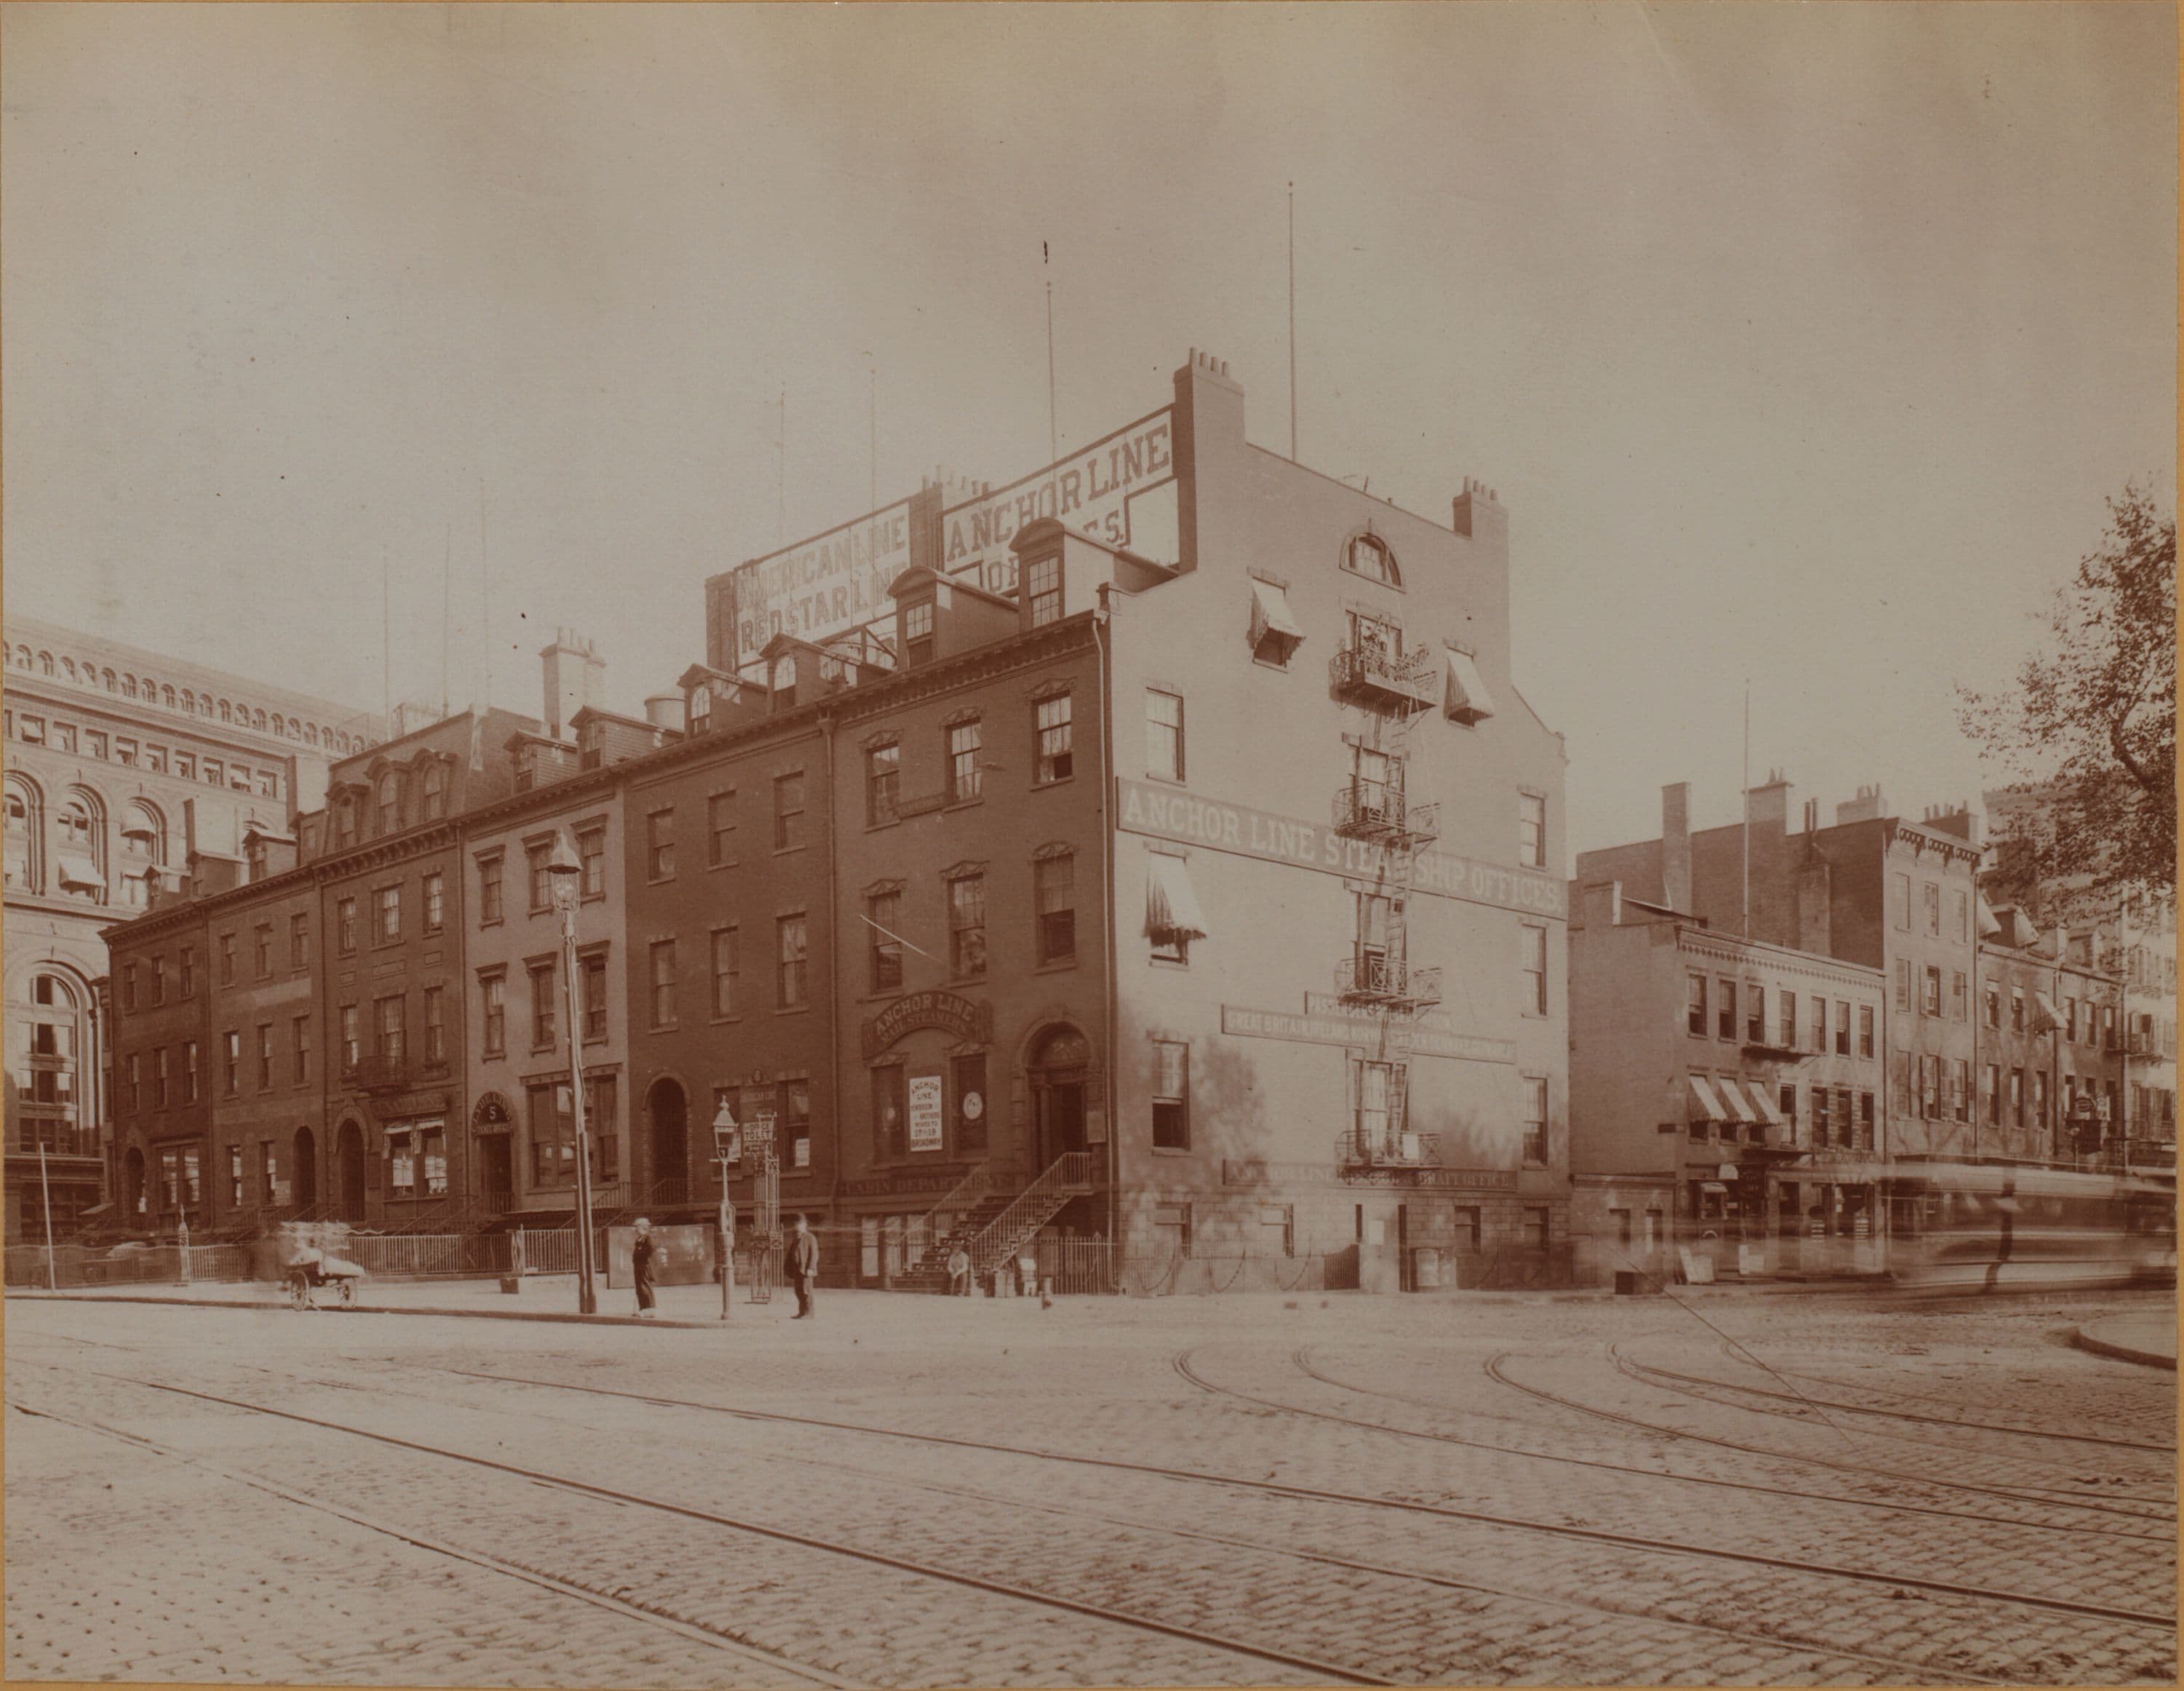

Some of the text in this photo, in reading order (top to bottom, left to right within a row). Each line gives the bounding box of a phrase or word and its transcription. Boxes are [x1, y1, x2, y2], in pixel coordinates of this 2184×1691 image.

[947, 423, 1170, 562] ANCHOR LINE
[736, 514, 907, 613] AMERICAN LINE
[741, 608, 782, 654] RED
[785, 584, 849, 637] STAR
[1123, 787, 1241, 846] ANCHOR
[1250, 815, 1316, 862] LINE
[1471, 865, 1564, 914] OFFICES.
[875, 994, 932, 1036] ANCHOR
[937, 994, 974, 1022] LINE
[910, 1081, 939, 1100] ANCHOR LINE
[488, 1105, 497, 1121] 5
[750, 1123, 769, 1131] OFFCE
[744, 1131, 755, 1139] TO
[846, 1180, 892, 1195] CABIN
